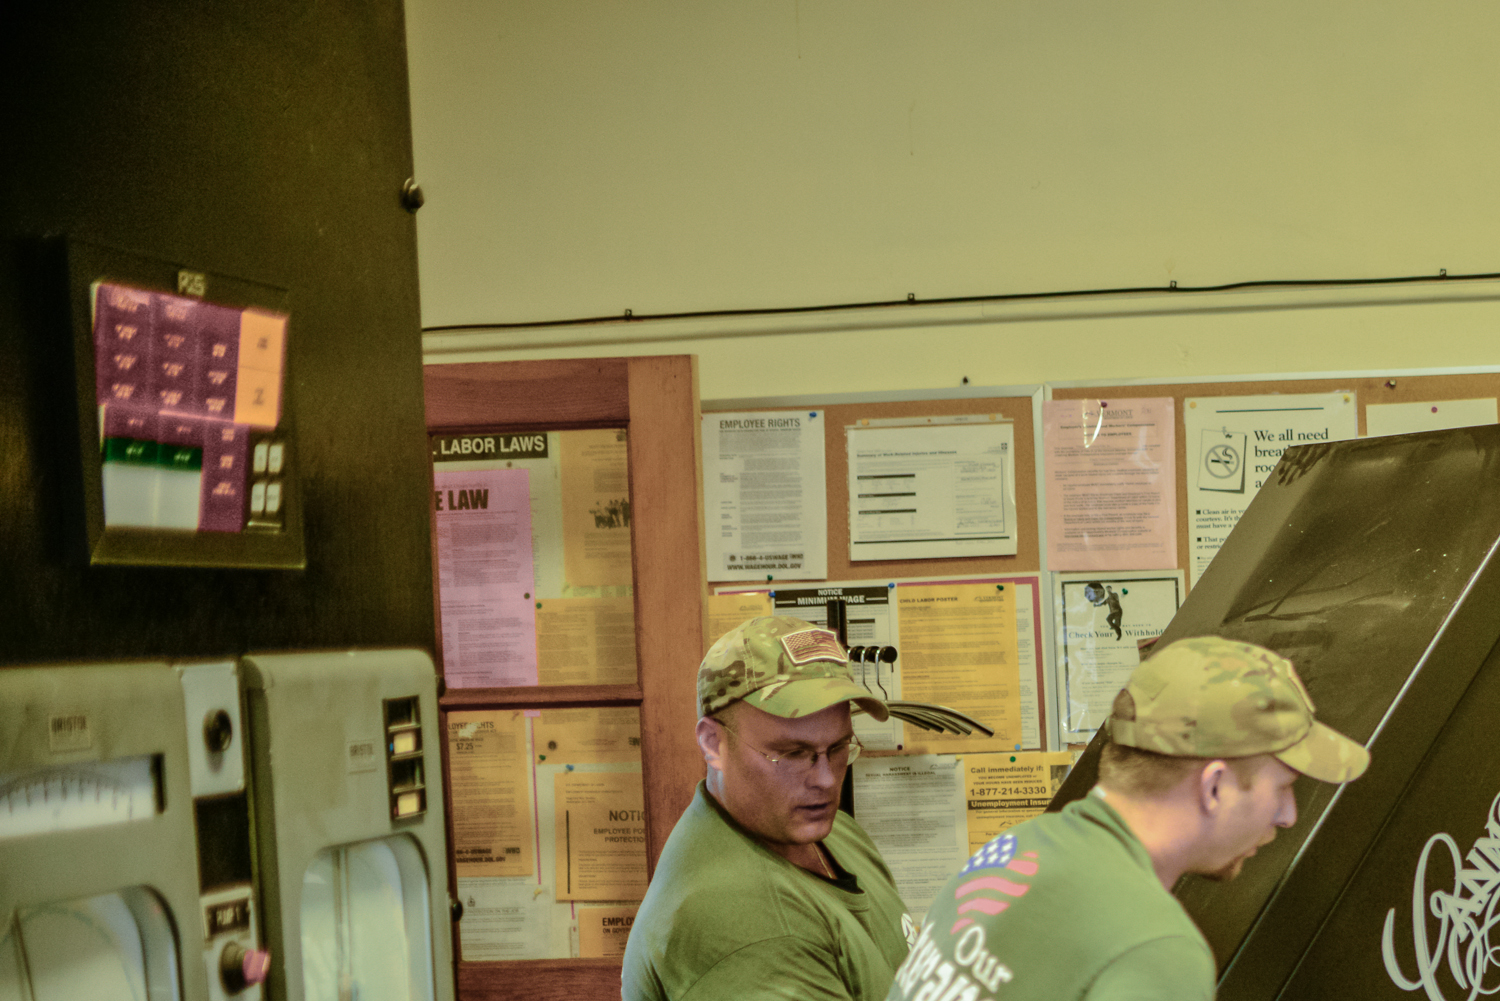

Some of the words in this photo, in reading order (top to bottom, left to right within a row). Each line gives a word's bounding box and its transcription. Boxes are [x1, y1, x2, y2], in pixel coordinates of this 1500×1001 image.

[720, 419, 766, 429] EMPLOYEE
[768, 418, 801, 427] RIGHTS
[1254, 430, 1275, 442] We
[1278, 428, 1294, 441] all
[1298, 428, 1329, 440] need
[441, 437, 495, 455] LABOR
[500, 435, 545, 453] LAWS
[448, 488, 489, 511] LAW
[818, 588, 843, 596] NOTICE
[1069, 631, 1093, 639] Check
[456, 742, 473, 750] $7.25
[970, 786, 1047, 796] 1-877-214-3330
[971, 800, 1028, 808] Unemployment
[955, 925, 1013, 993] Our
